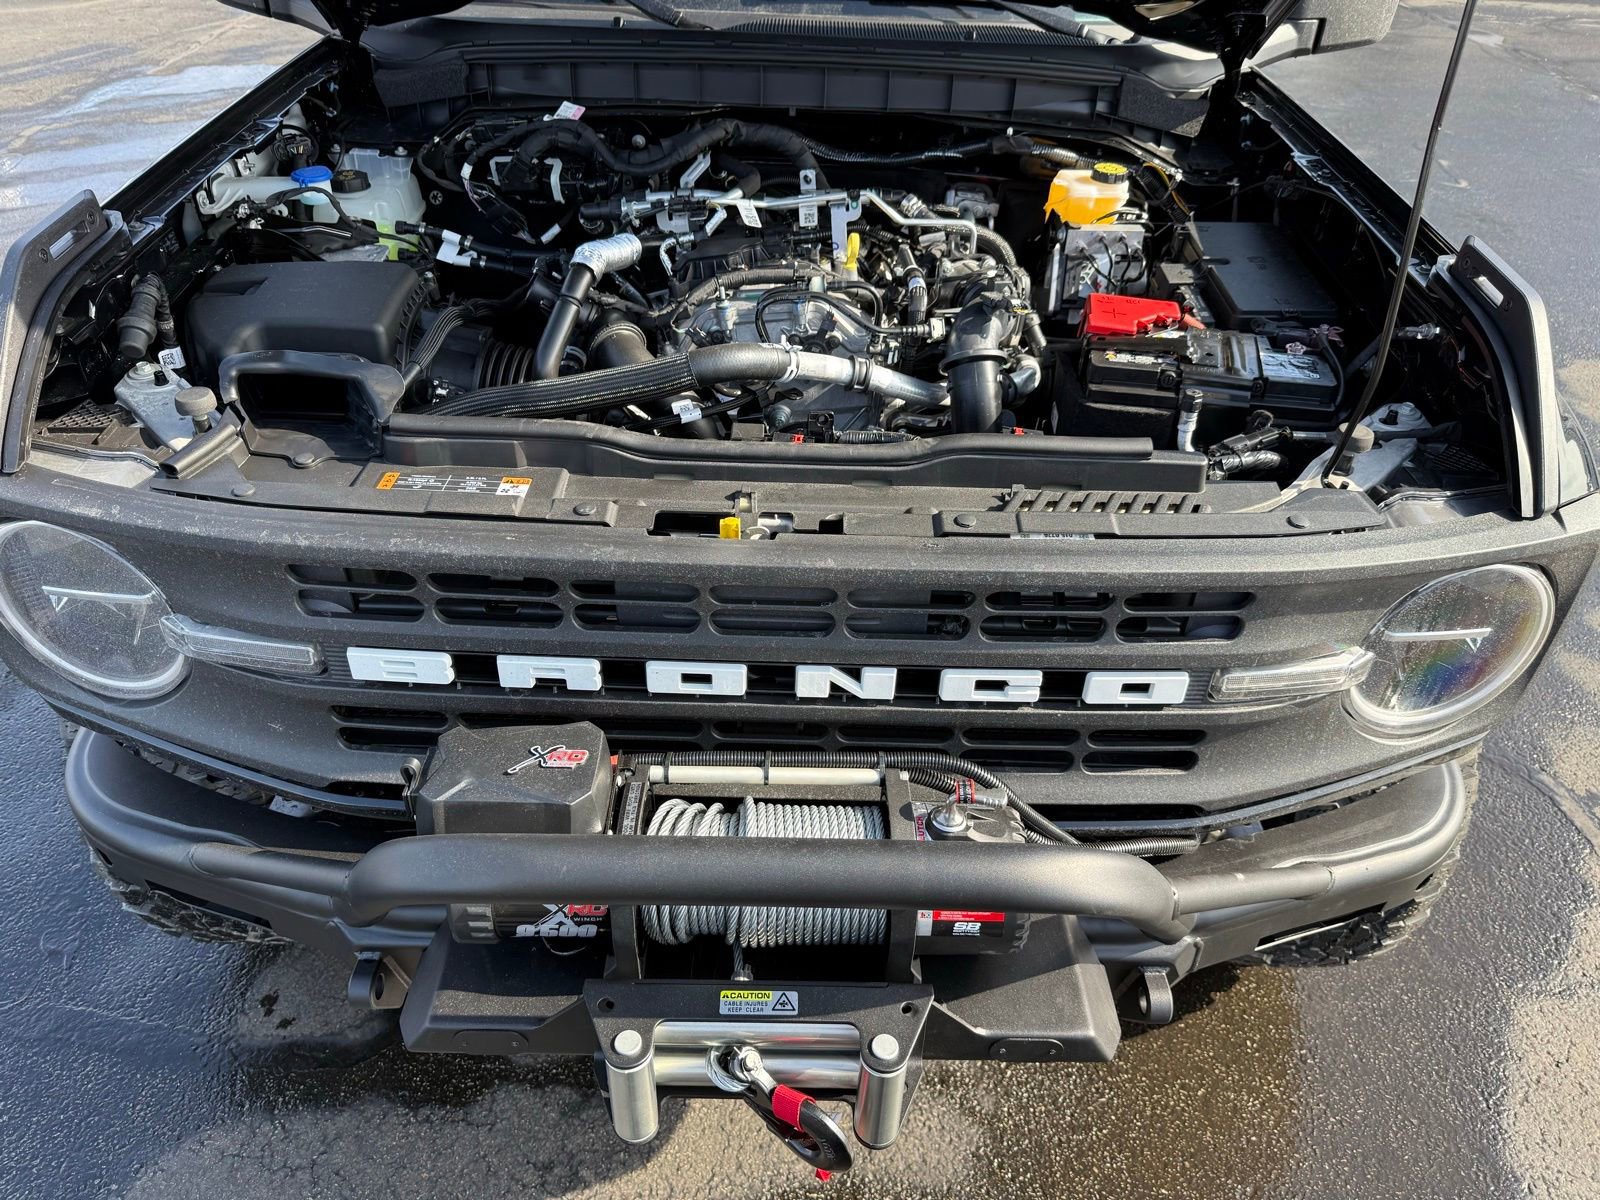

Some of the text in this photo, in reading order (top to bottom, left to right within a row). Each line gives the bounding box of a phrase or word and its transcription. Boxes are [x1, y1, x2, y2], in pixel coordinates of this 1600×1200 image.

[346, 646, 1191, 706] BRONCO
[507, 745, 589, 773] XRC
[915, 816, 925, 841] LUTCH
